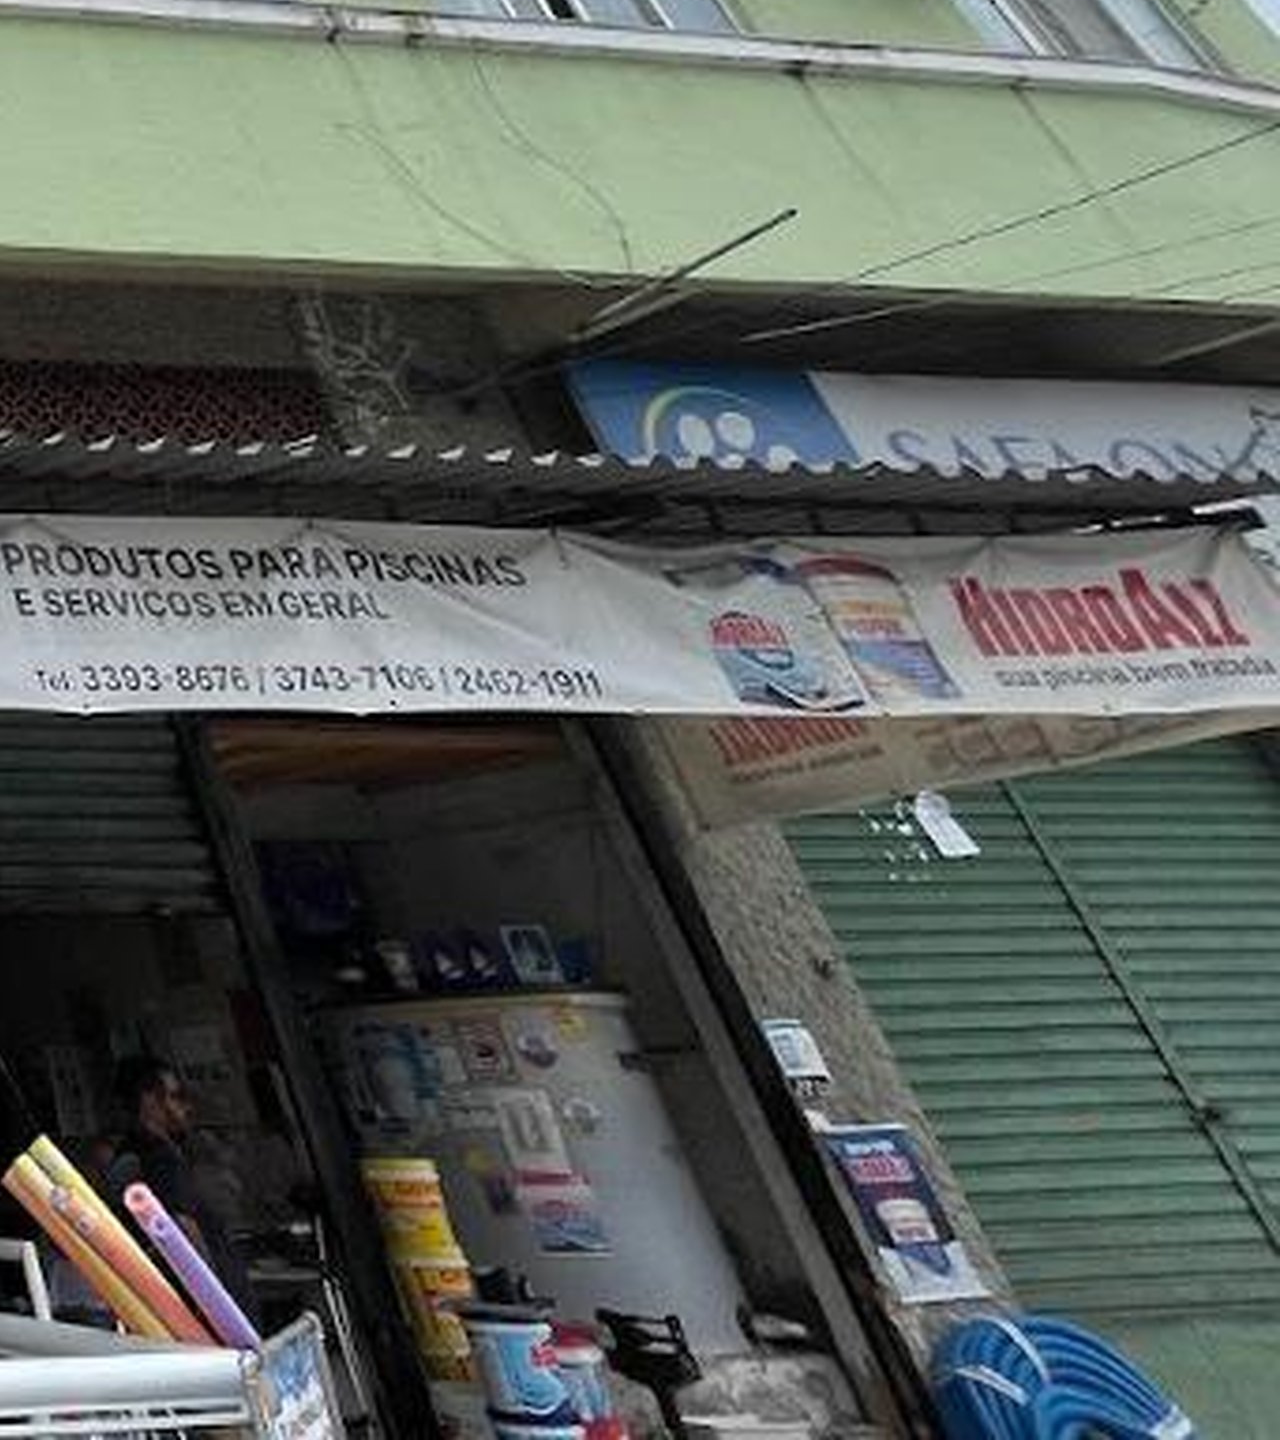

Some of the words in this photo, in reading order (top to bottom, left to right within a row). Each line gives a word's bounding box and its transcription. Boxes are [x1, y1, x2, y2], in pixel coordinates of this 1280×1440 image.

[1, 543, 223, 580] PRODUTOS
[229, 546, 343, 580] PARA
[345, 549, 528, 587] PISCINAS
[14, 588, 37, 617] E
[218, 591, 275, 618] EM
[277, 591, 390, 621] GERAL
[81, 664, 250, 692] 3393-8676
